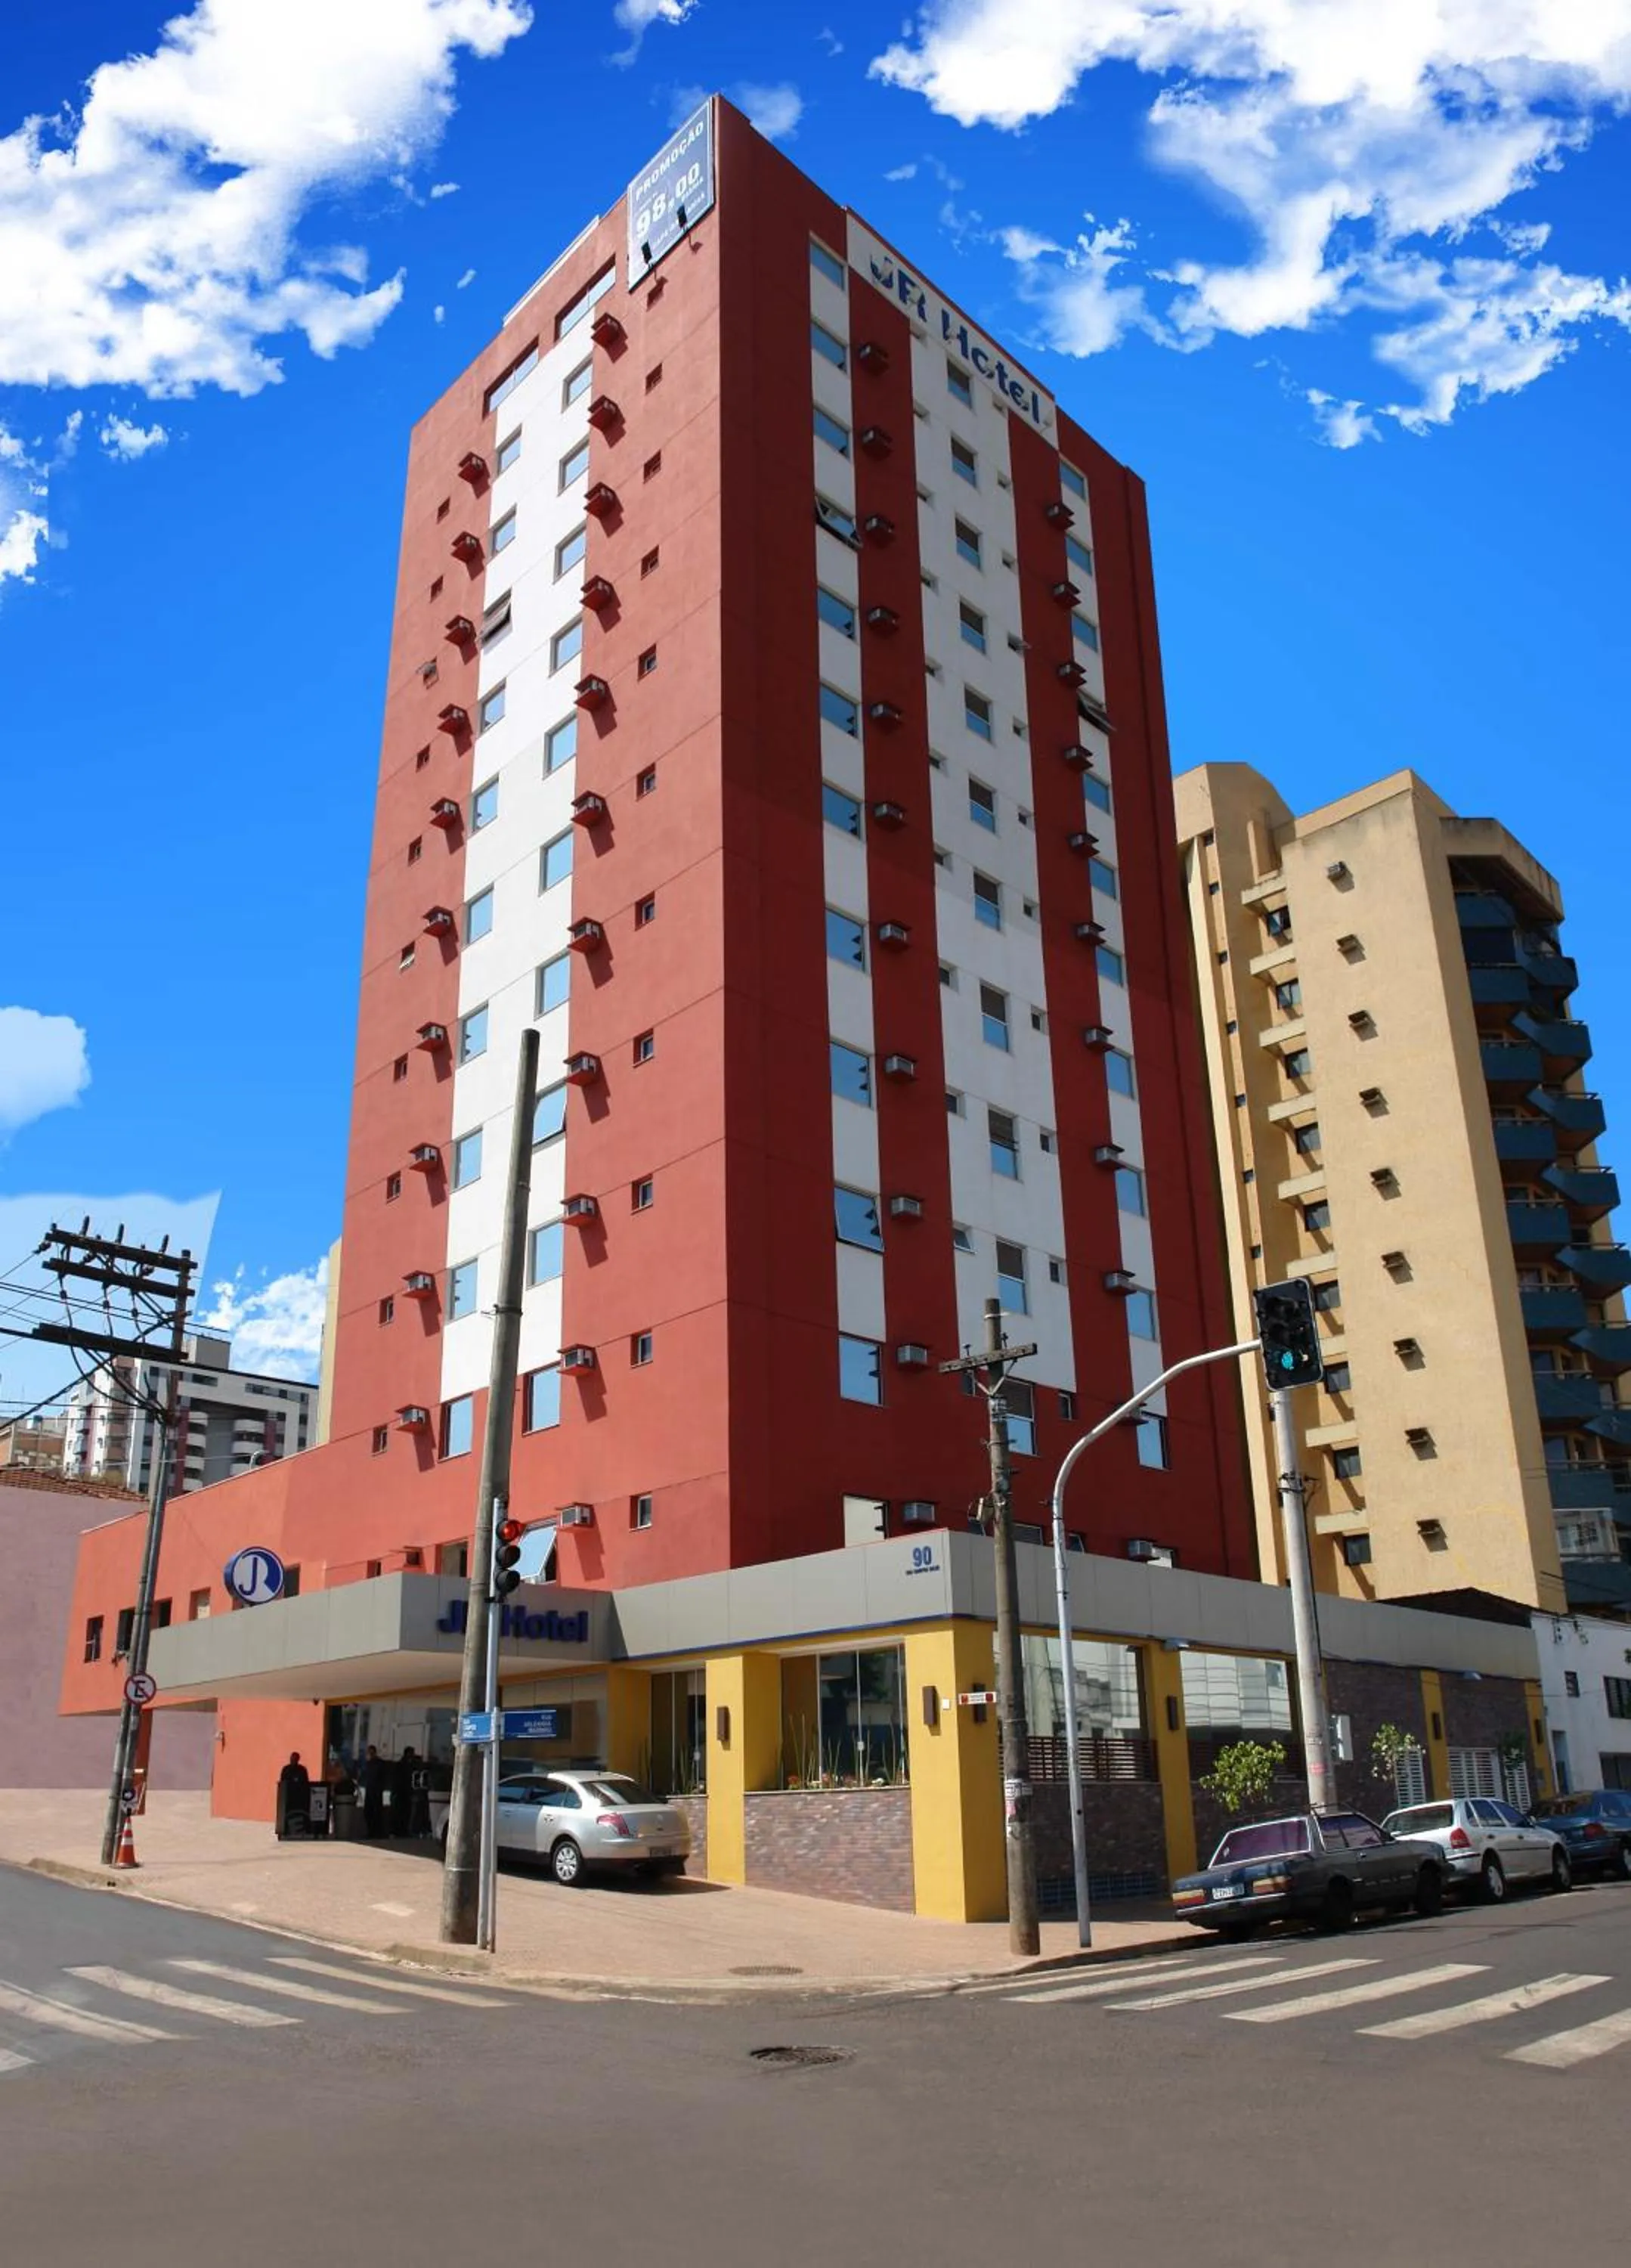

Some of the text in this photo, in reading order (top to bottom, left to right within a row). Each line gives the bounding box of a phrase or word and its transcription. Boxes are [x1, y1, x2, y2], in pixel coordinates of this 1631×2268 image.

[636, 121, 704, 203] PROMOÇÃO
[941, 308, 1040, 423] Hotel
[912, 1545, 932, 1567] 90
[500, 1603, 589, 1643] Hotel
